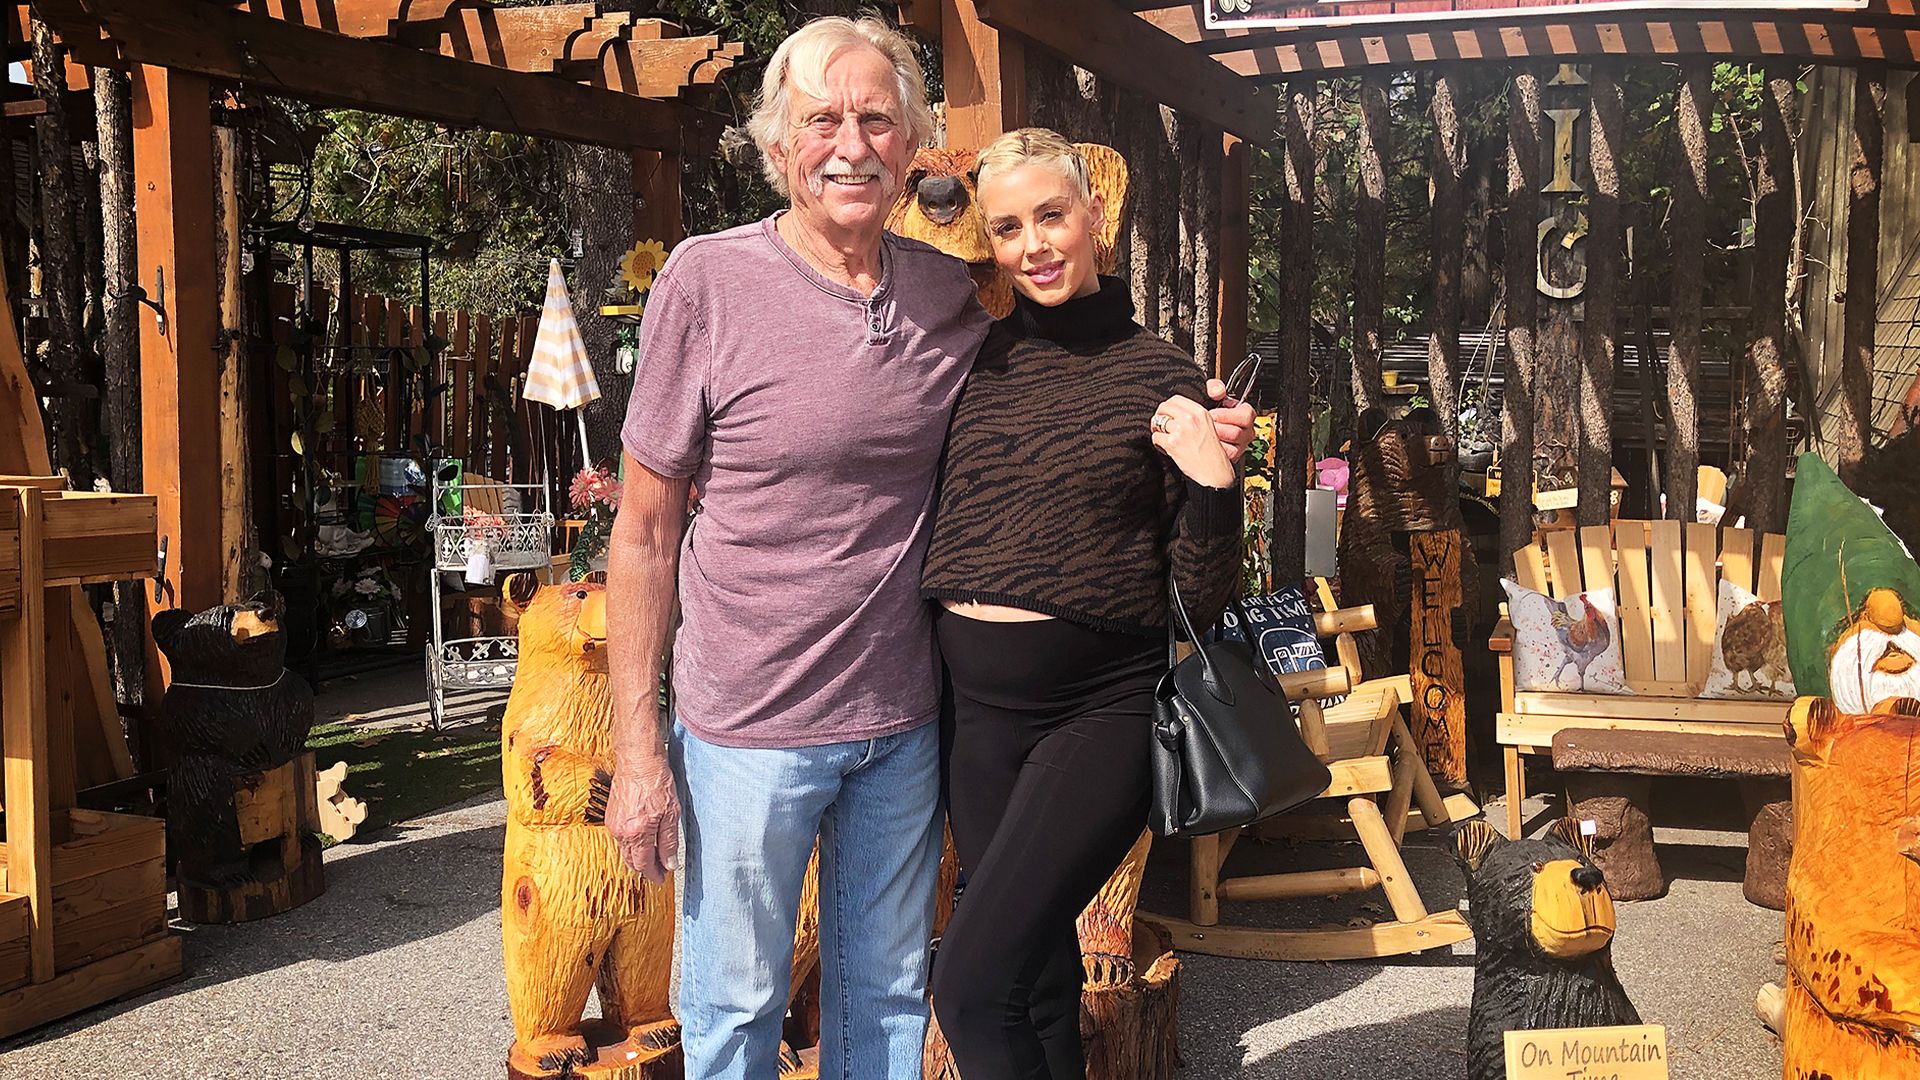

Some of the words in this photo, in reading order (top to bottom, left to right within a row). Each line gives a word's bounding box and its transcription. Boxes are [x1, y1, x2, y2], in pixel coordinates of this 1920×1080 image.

[1265, 599, 1312, 620] TIME
[1417, 541, 1450, 775] WELCOME
[1521, 1041, 1552, 1068] On
[1561, 1034, 1661, 1067] Mountain
